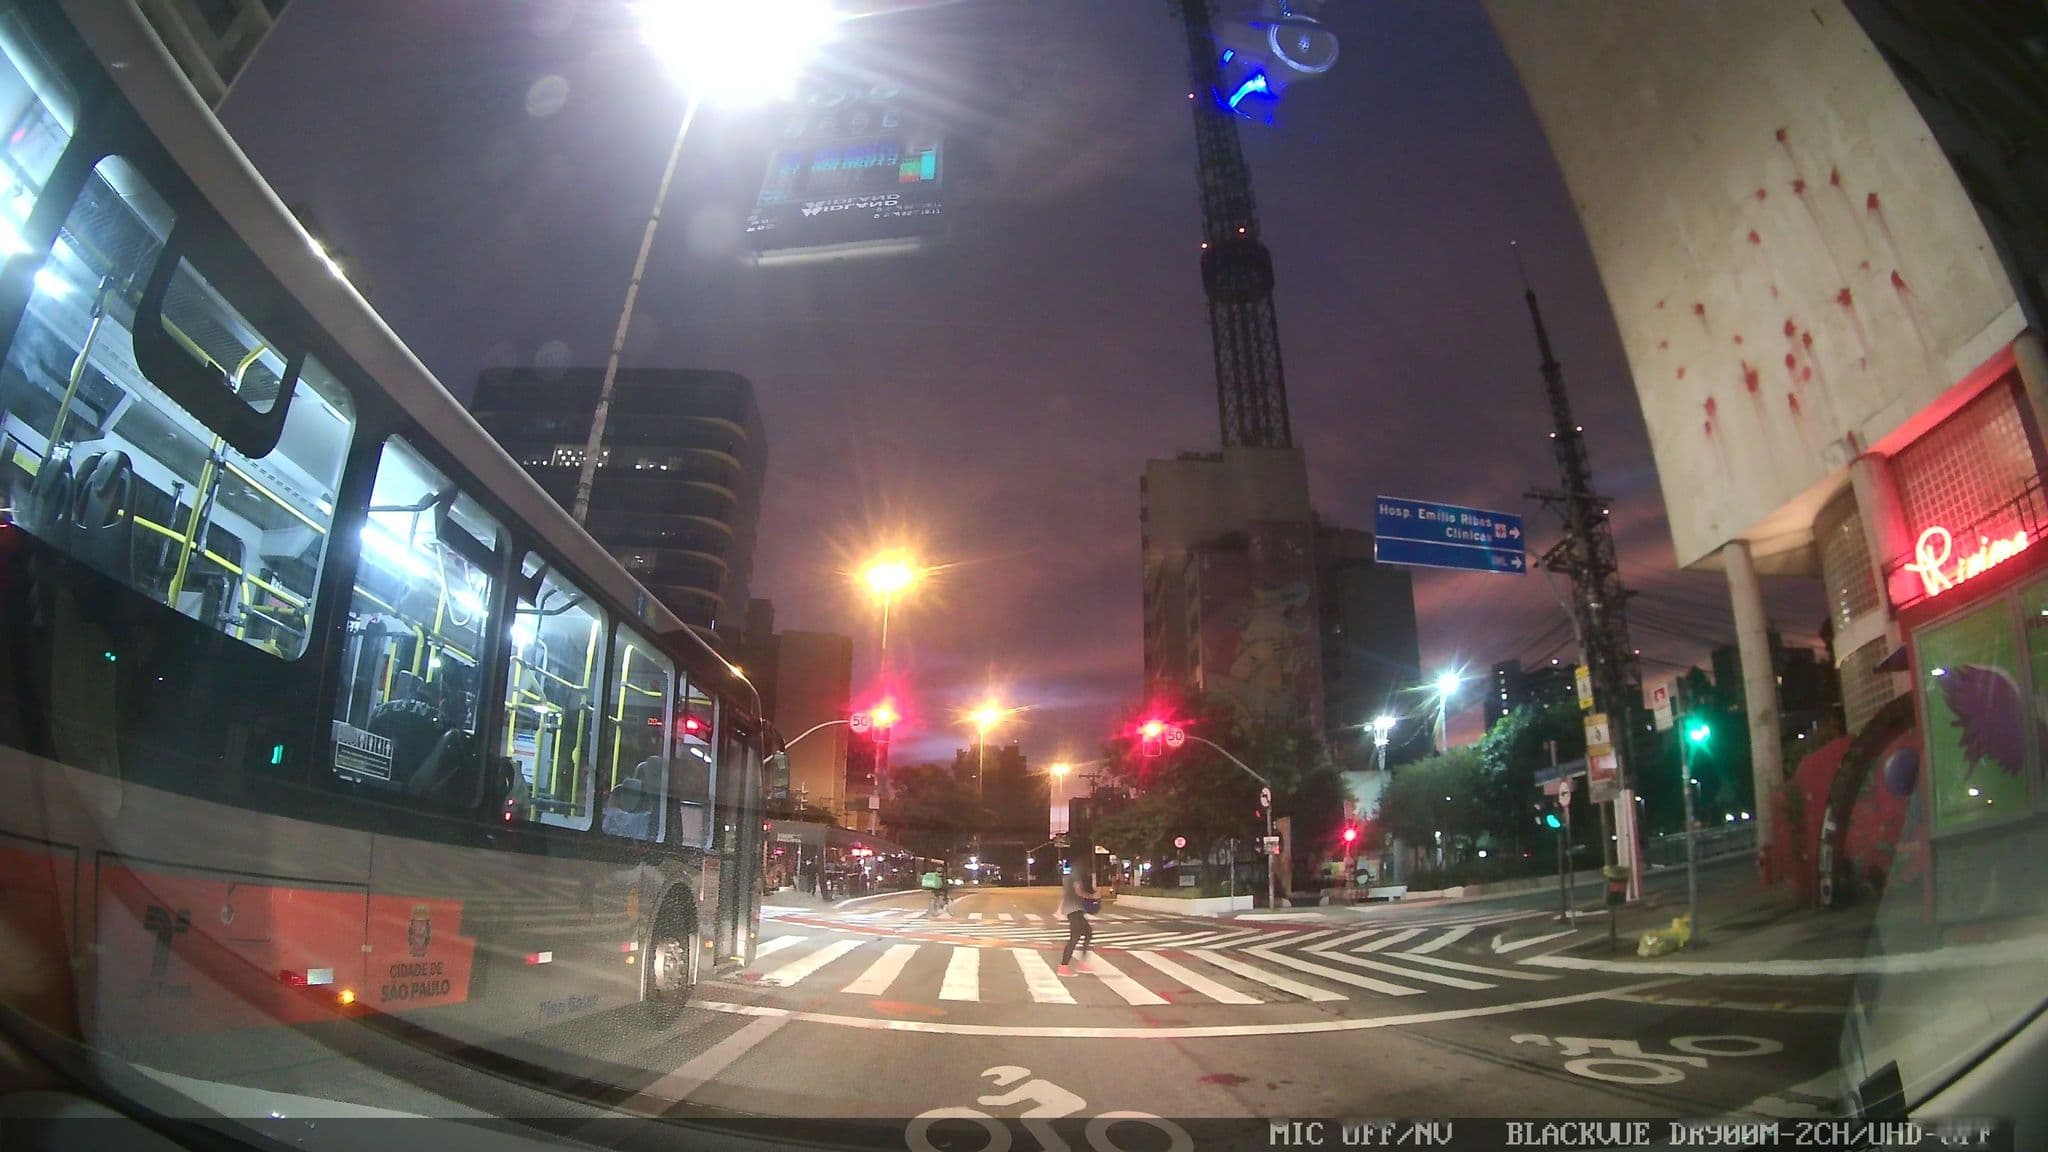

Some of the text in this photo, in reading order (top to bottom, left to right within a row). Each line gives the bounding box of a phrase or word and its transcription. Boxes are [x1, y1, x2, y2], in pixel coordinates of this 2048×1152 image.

[1379, 503, 1412, 519] Hosp.
[1461, 514, 1492, 528] Ribas
[853, 715, 868, 727] 50
[1168, 730, 1183, 742] 50
[389, 960, 444, 978] CIDADE DE
[411, 978, 450, 999] PAULO
